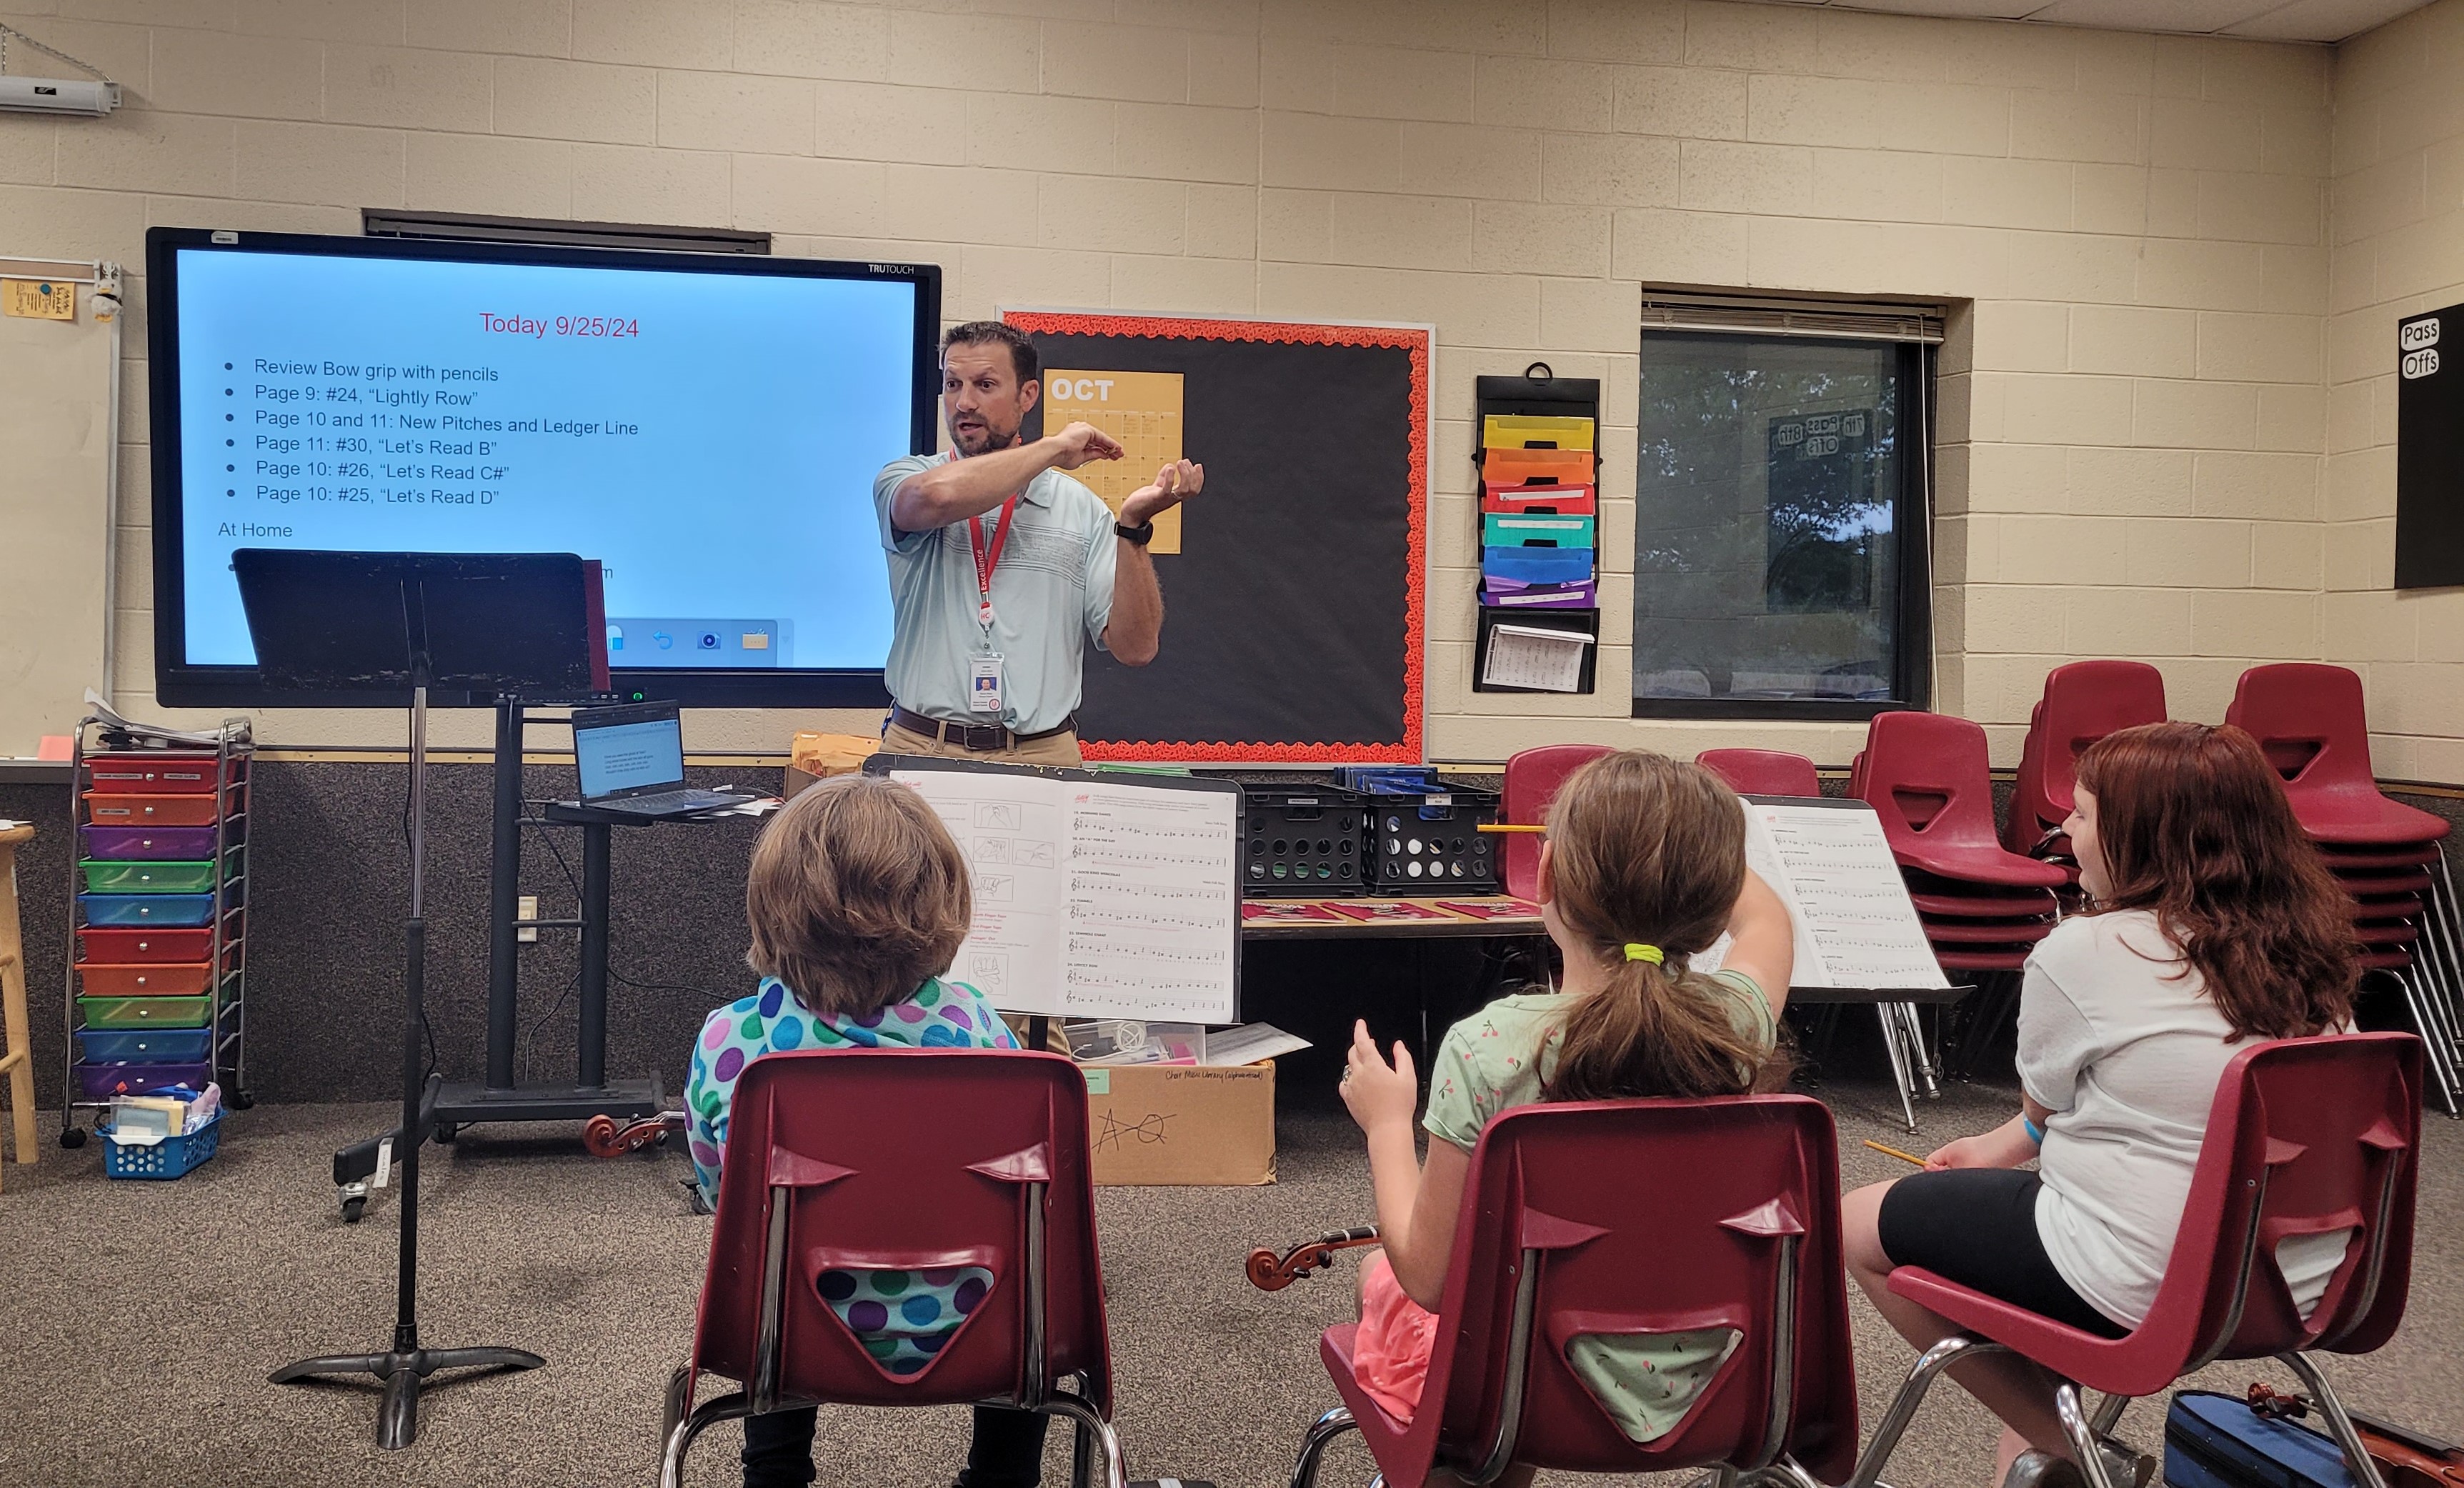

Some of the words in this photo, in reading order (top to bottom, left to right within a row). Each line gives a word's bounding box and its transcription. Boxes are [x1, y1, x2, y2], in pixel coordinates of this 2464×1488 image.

[868, 264, 914, 275] TRUTOUCH
[479, 313, 547, 339] Today
[556, 316, 639, 338] 9/25/24
[2405, 323, 2438, 344] Pass
[254, 359, 318, 375] Review
[323, 361, 360, 377] Bow
[365, 363, 397, 382] grip
[401, 364, 435, 380] with
[441, 366, 499, 384] pencils
[2405, 351, 2437, 375] Offs
[255, 384, 299, 404] Page
[305, 386, 320, 401] 9:
[326, 386, 363, 405] #24,
[1052, 378, 1114, 401] OCT
[256, 409, 300, 429] Page
[306, 411, 326, 426] 10
[331, 412, 363, 428] and
[370, 413, 393, 429] 11:
[399, 414, 437, 430] New
[442, 415, 502, 431] Pitches
[507, 418, 538, 433] and
[544, 418, 601, 438] Ledger
[605, 420, 639, 436] Line
[256, 434, 300, 454] Page
[306, 436, 330, 451] 11:
[335, 436, 372, 455] #30,
[429, 439, 473, 456] Read
[256, 460, 301, 479] Page
[307, 461, 331, 476] 10:
[337, 462, 374, 480] #26,
[431, 464, 474, 480] Read
[256, 485, 301, 504] Page
[307, 486, 332, 501] 10:
[337, 486, 374, 504] #25,
[432, 489, 474, 504] Read
[217, 521, 237, 536] At
[242, 522, 293, 537] Home
[977, 549, 987, 591] Excellence
[1166, 1071, 1182, 1080] Choir
[1202, 1071, 1224, 1084] Library
